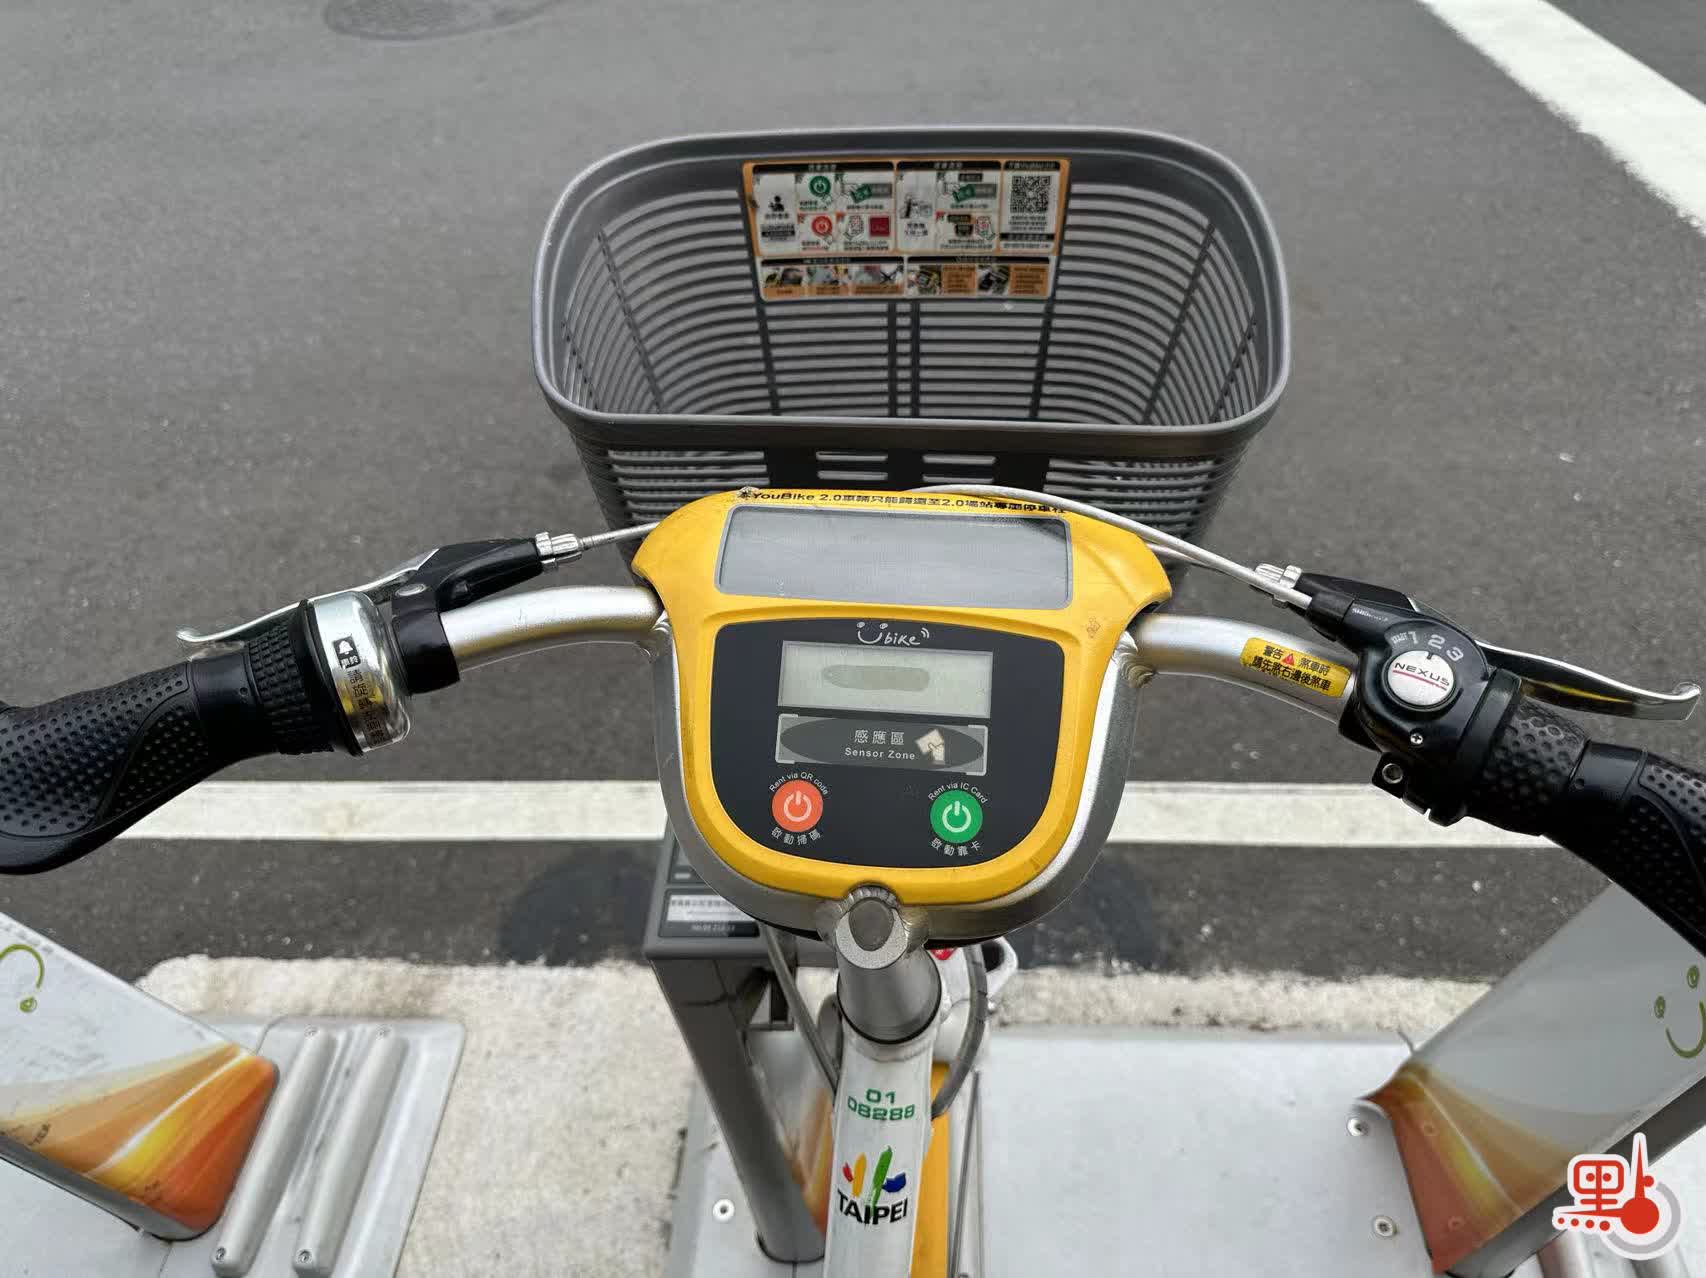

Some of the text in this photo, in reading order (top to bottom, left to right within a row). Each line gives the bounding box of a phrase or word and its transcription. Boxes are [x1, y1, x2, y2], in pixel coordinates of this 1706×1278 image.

[1265, 645, 1284, 659] 警告
[1428, 634, 1446, 649] 2
[1447, 647, 1464, 661] 3
[1394, 662, 1451, 687] NEXUS
[854, 729, 905, 746] 感應區
[844, 747, 915, 760] Sensor Zone
[769, 776, 786, 791] Rent
[800, 771, 814, 780] QR
[814, 778, 829, 795] code
[928, 785, 945, 800] Rent
[960, 782, 970, 790] IC
[971, 786, 988, 804] Card
[865, 1088, 896, 1104] 01
[847, 1096, 915, 1121] 08288
[837, 1187, 908, 1226] TAIPEI
